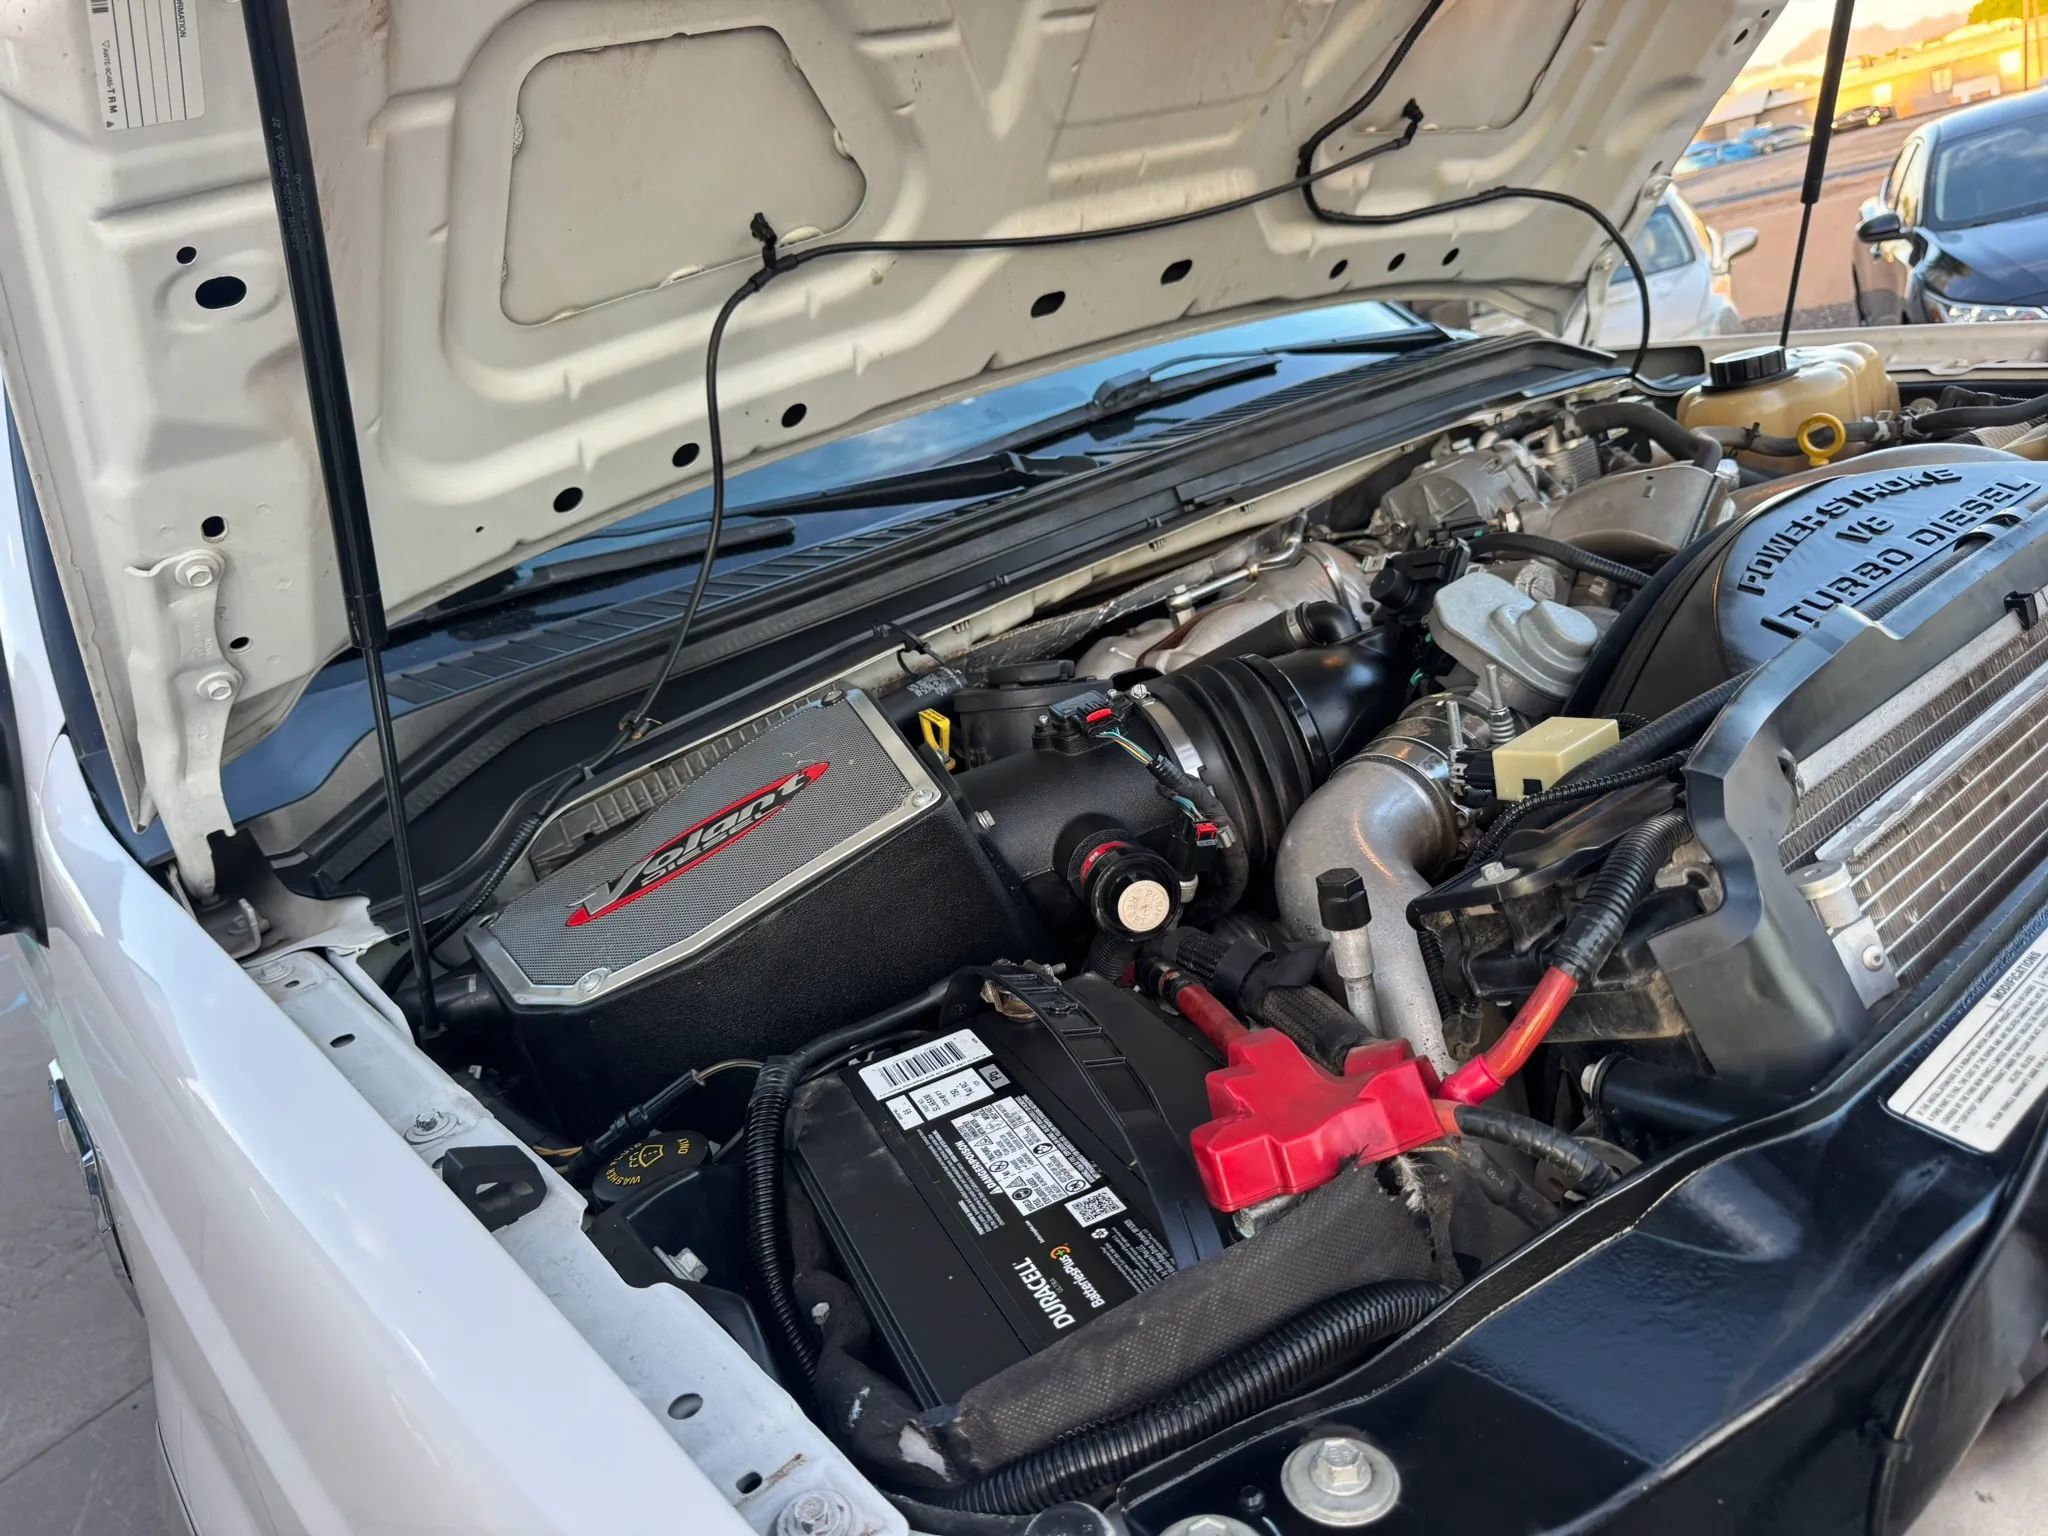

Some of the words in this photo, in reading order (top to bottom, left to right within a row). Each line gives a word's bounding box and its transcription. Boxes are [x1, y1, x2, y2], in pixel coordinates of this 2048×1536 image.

[1783, 548, 1916, 630] TURBO
[1906, 478, 2035, 548] DIESEL
[1835, 515, 1894, 544] V8
[568, 772, 812, 916] Volant
[1990, 951, 2042, 1001] MODIFICATIONS
[985, 1069, 1003, 1082] Pb
[677, 1137, 690, 1155] ONLY
[953, 1139, 997, 1190] DANGER/POISON
[606, 1167, 641, 1187] WASHER
[1015, 1256, 1076, 1329] DURACELL
[1057, 1253, 1106, 1308] BatteriesPlus
